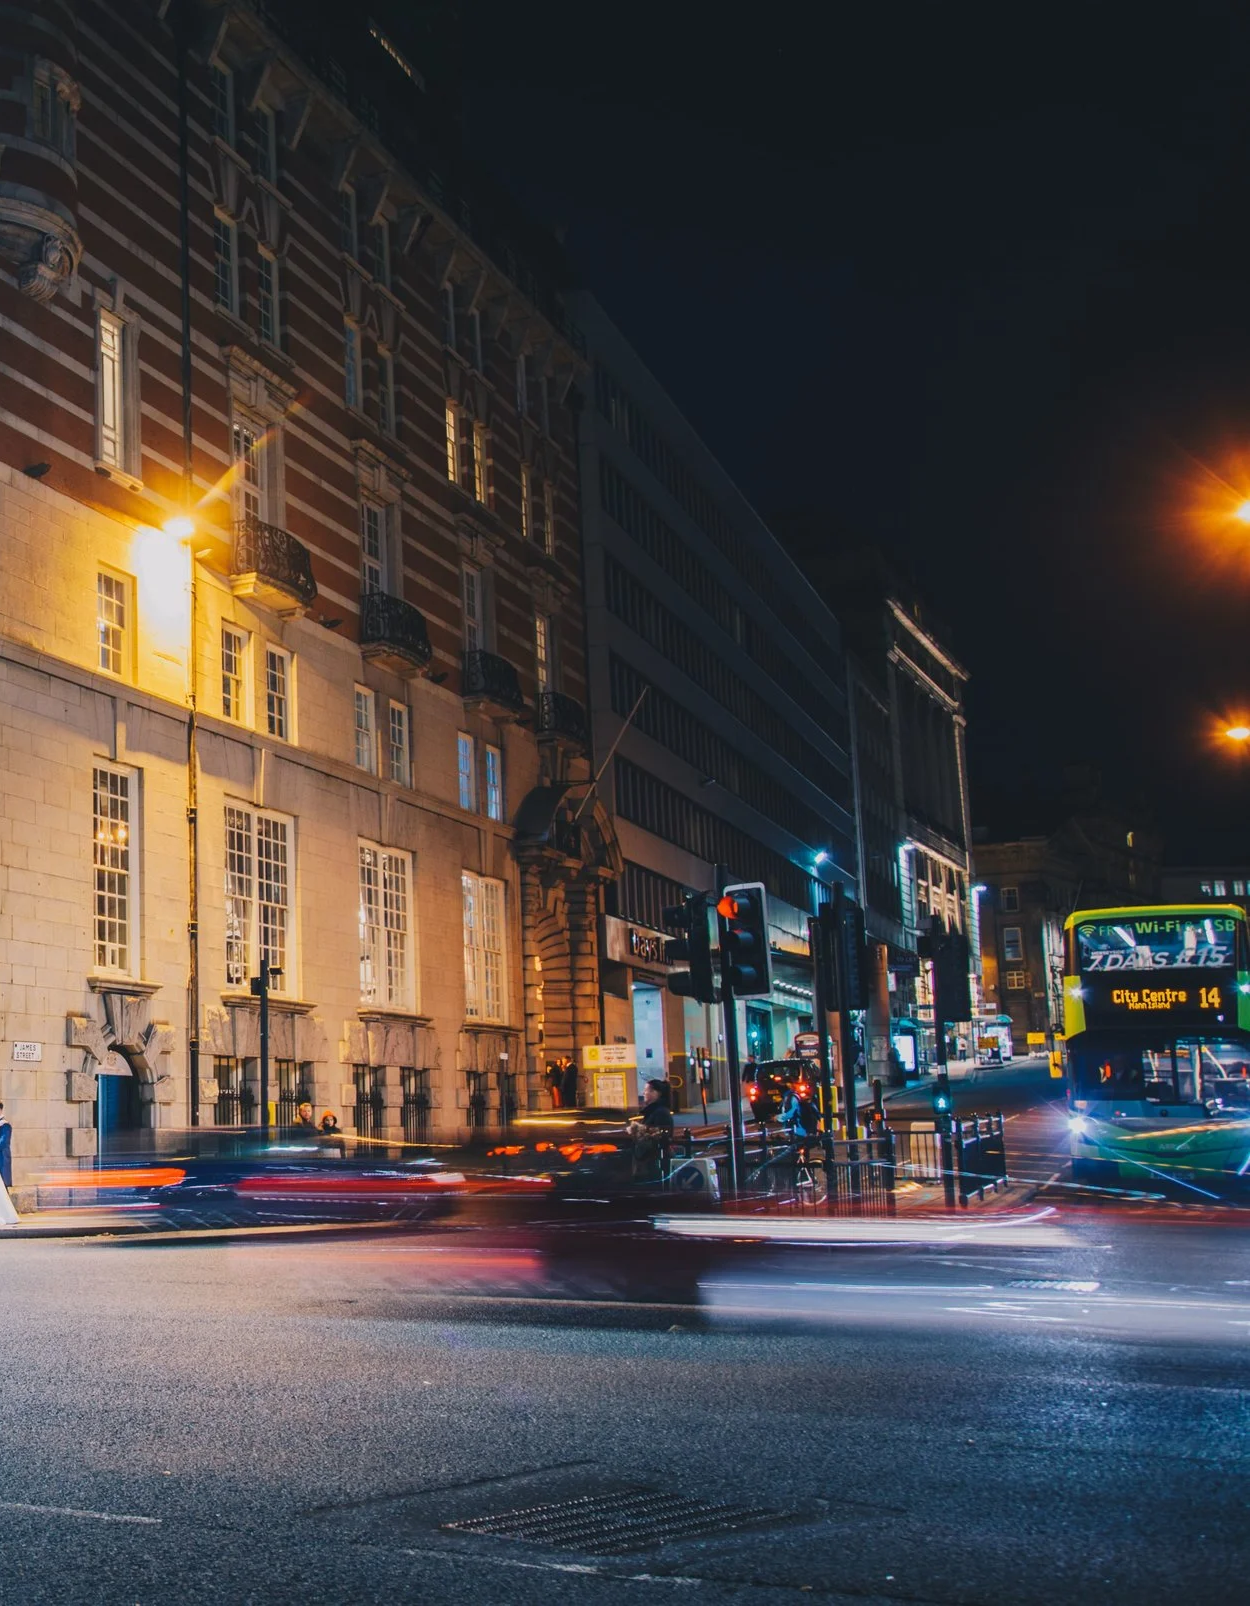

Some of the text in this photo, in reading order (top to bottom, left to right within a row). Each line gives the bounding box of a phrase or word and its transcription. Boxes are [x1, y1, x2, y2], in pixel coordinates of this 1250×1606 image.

[1099, 924, 1132, 936] FR
[1135, 920, 1181, 934] Wi-Fi
[1087, 955, 1104, 972] 7
[1112, 987, 1220, 1008] City Centre 14
[16, 1051, 35, 1061] STREET
[19, 1044, 37, 1052] JAMES
